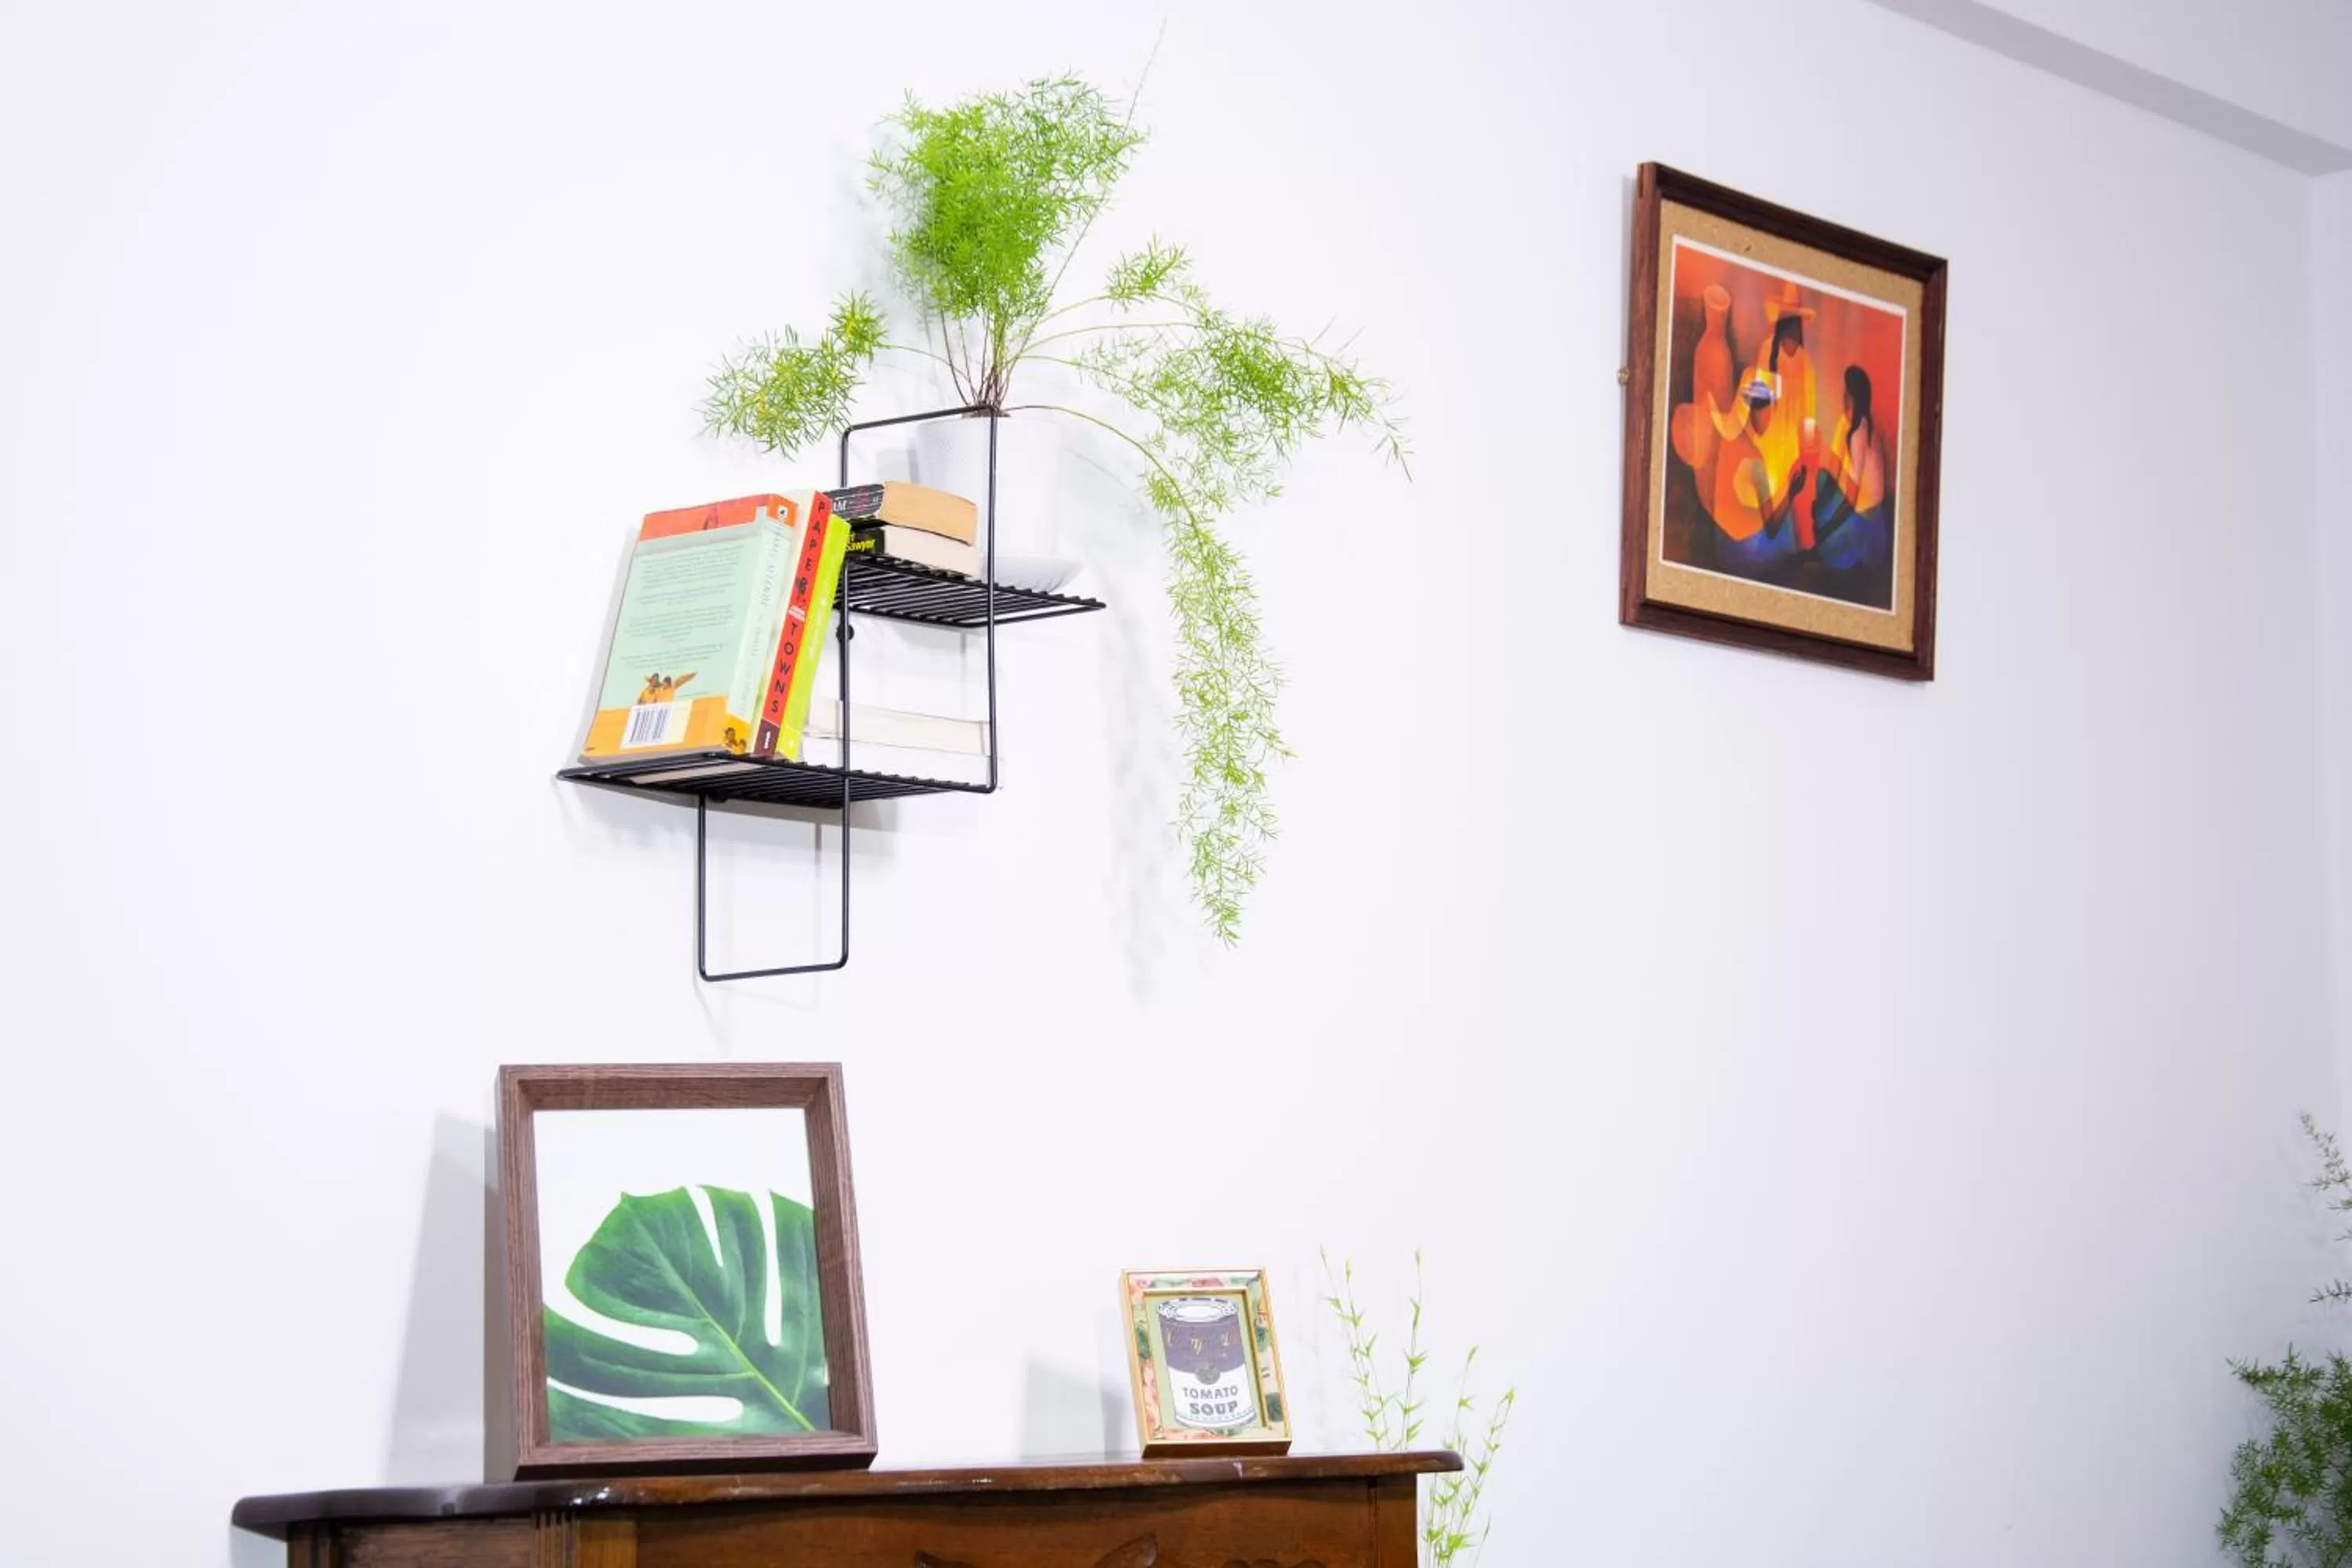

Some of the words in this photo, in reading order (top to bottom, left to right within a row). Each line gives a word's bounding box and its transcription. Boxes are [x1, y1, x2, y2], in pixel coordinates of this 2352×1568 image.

[771, 622, 798, 713] TOWNS
[1182, 1385, 1238, 1399] TOMATO
[1189, 1400, 1238, 1416] SOUP
